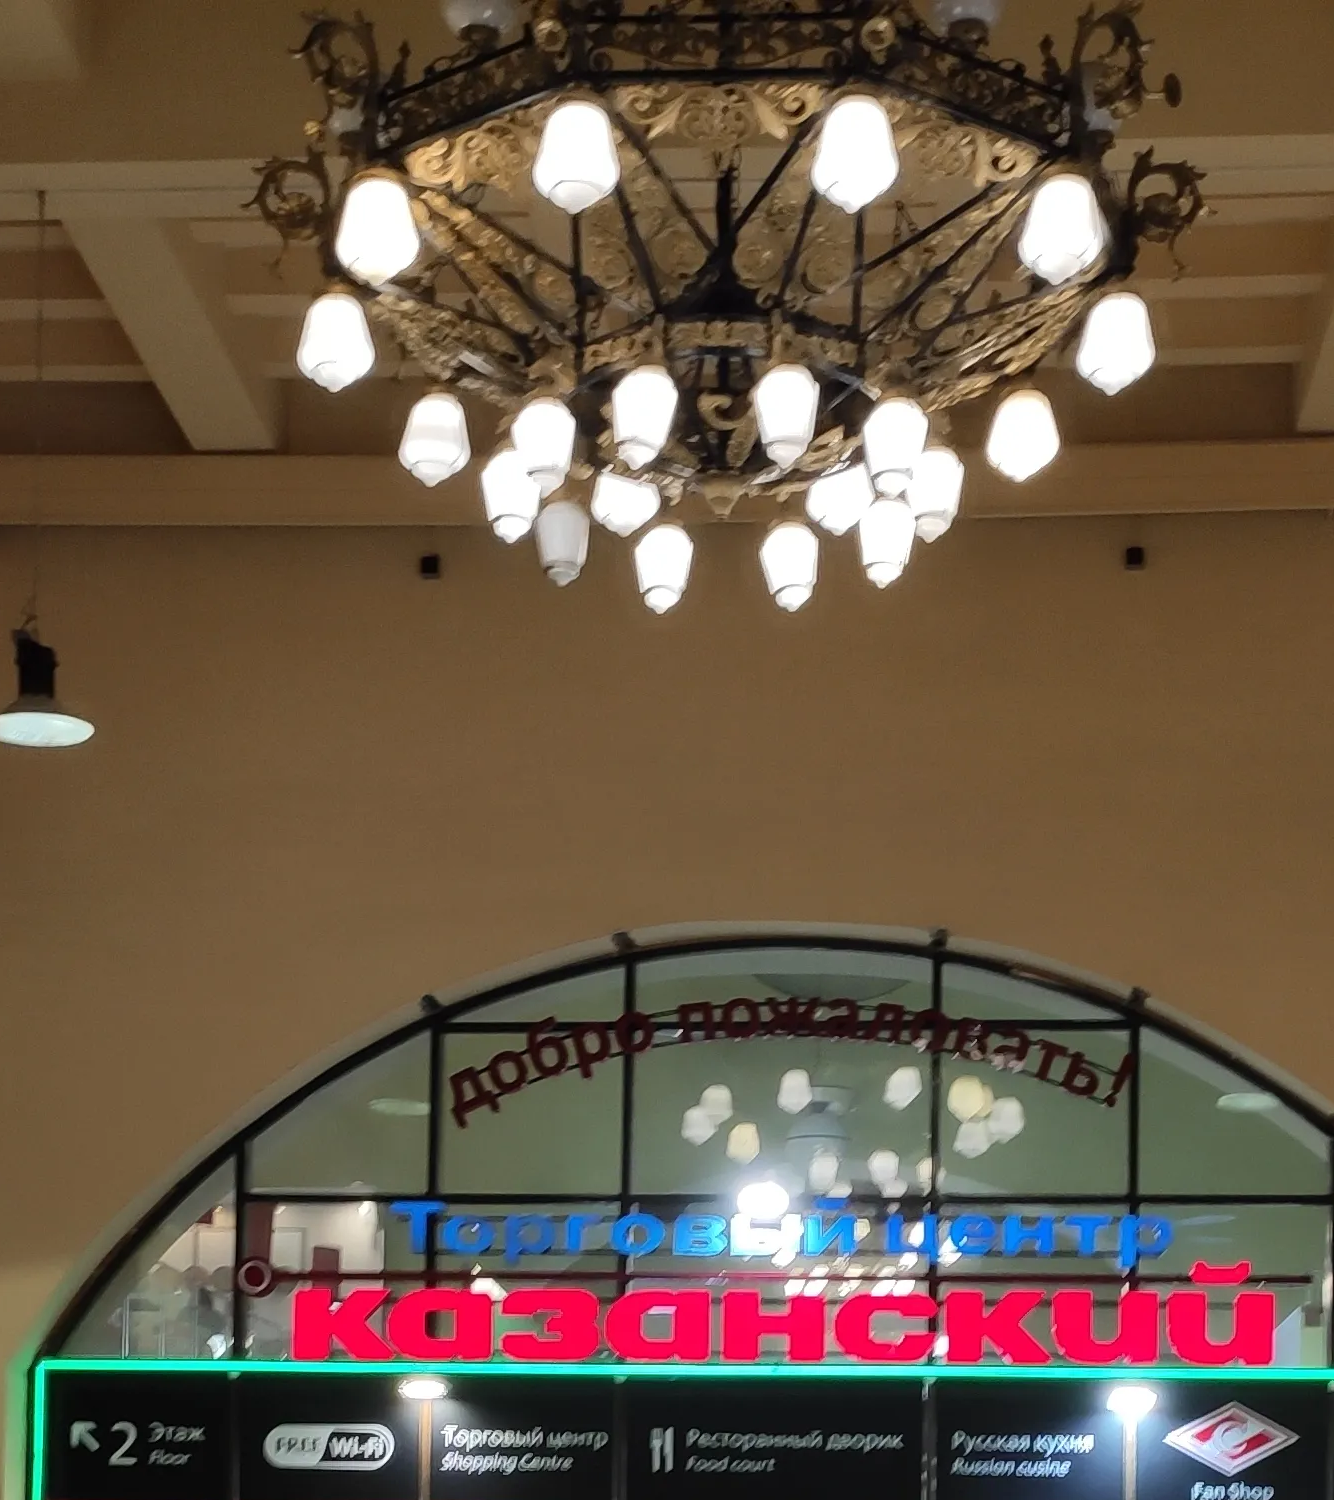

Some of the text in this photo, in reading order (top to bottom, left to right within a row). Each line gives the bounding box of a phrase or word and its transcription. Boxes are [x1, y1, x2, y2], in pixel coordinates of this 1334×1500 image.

[444, 1016, 656, 1129] добро
[885, 1212, 1173, 1268] центр
[108, 1421, 138, 1466] 2
[147, 1421, 207, 1443] Этаж
[440, 1424, 609, 1452] Торговый центр
[685, 1428, 905, 1454] Ресторанный дворик
[951, 1430, 1095, 1458] Русская кухня
[147, 1449, 192, 1467] Floor
[329, 1434, 387, 1460] Wi-Fi
[439, 1451, 575, 1475] Shopping Centre
[685, 1455, 776, 1473] Food court
[950, 1457, 1016, 1476] Russian
